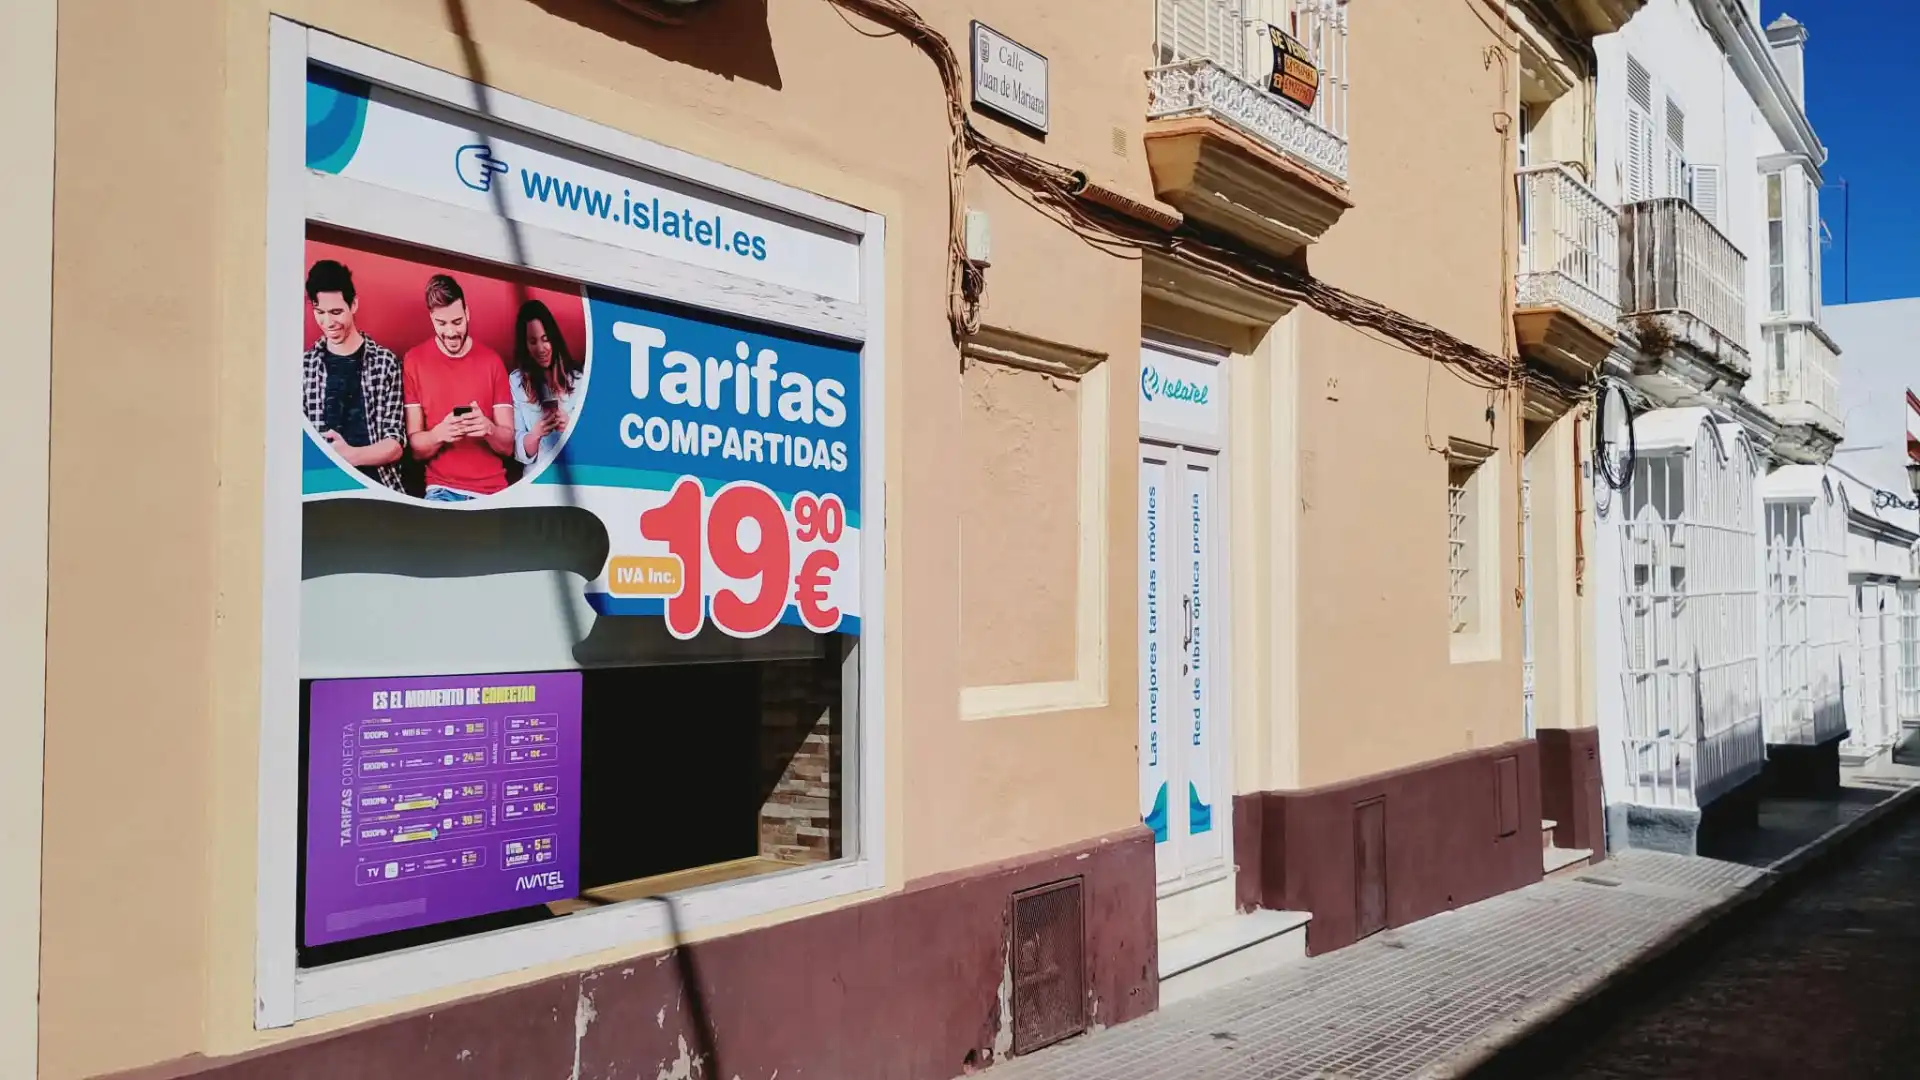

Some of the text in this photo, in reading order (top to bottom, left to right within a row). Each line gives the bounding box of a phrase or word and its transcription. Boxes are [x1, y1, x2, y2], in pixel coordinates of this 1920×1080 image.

[999, 46, 1024, 72] Calle
[1270, 27, 1286, 50] SE
[979, 63, 1045, 115] Juan de Mariana
[521, 168, 767, 261] www.islatel.es
[612, 321, 847, 428] Tarifas
[619, 413, 848, 472] COMPARTIDAS
[617, 567, 676, 585] IVA Inc.
[639, 480, 791, 634] 19
[1147, 486, 1159, 767] Las mejores tarifas móviles
[1191, 493, 1201, 746] Red de fibra óptica propia
[373, 691, 388, 709] ES
[390, 690, 403, 708] EL
[405, 688, 464, 708] MOMENTO
[466, 688, 480, 705] DE
[340, 722, 355, 847] TARIFAS CONECTA
[367, 867, 380, 878] TV
[516, 870, 565, 891] AVATEL
